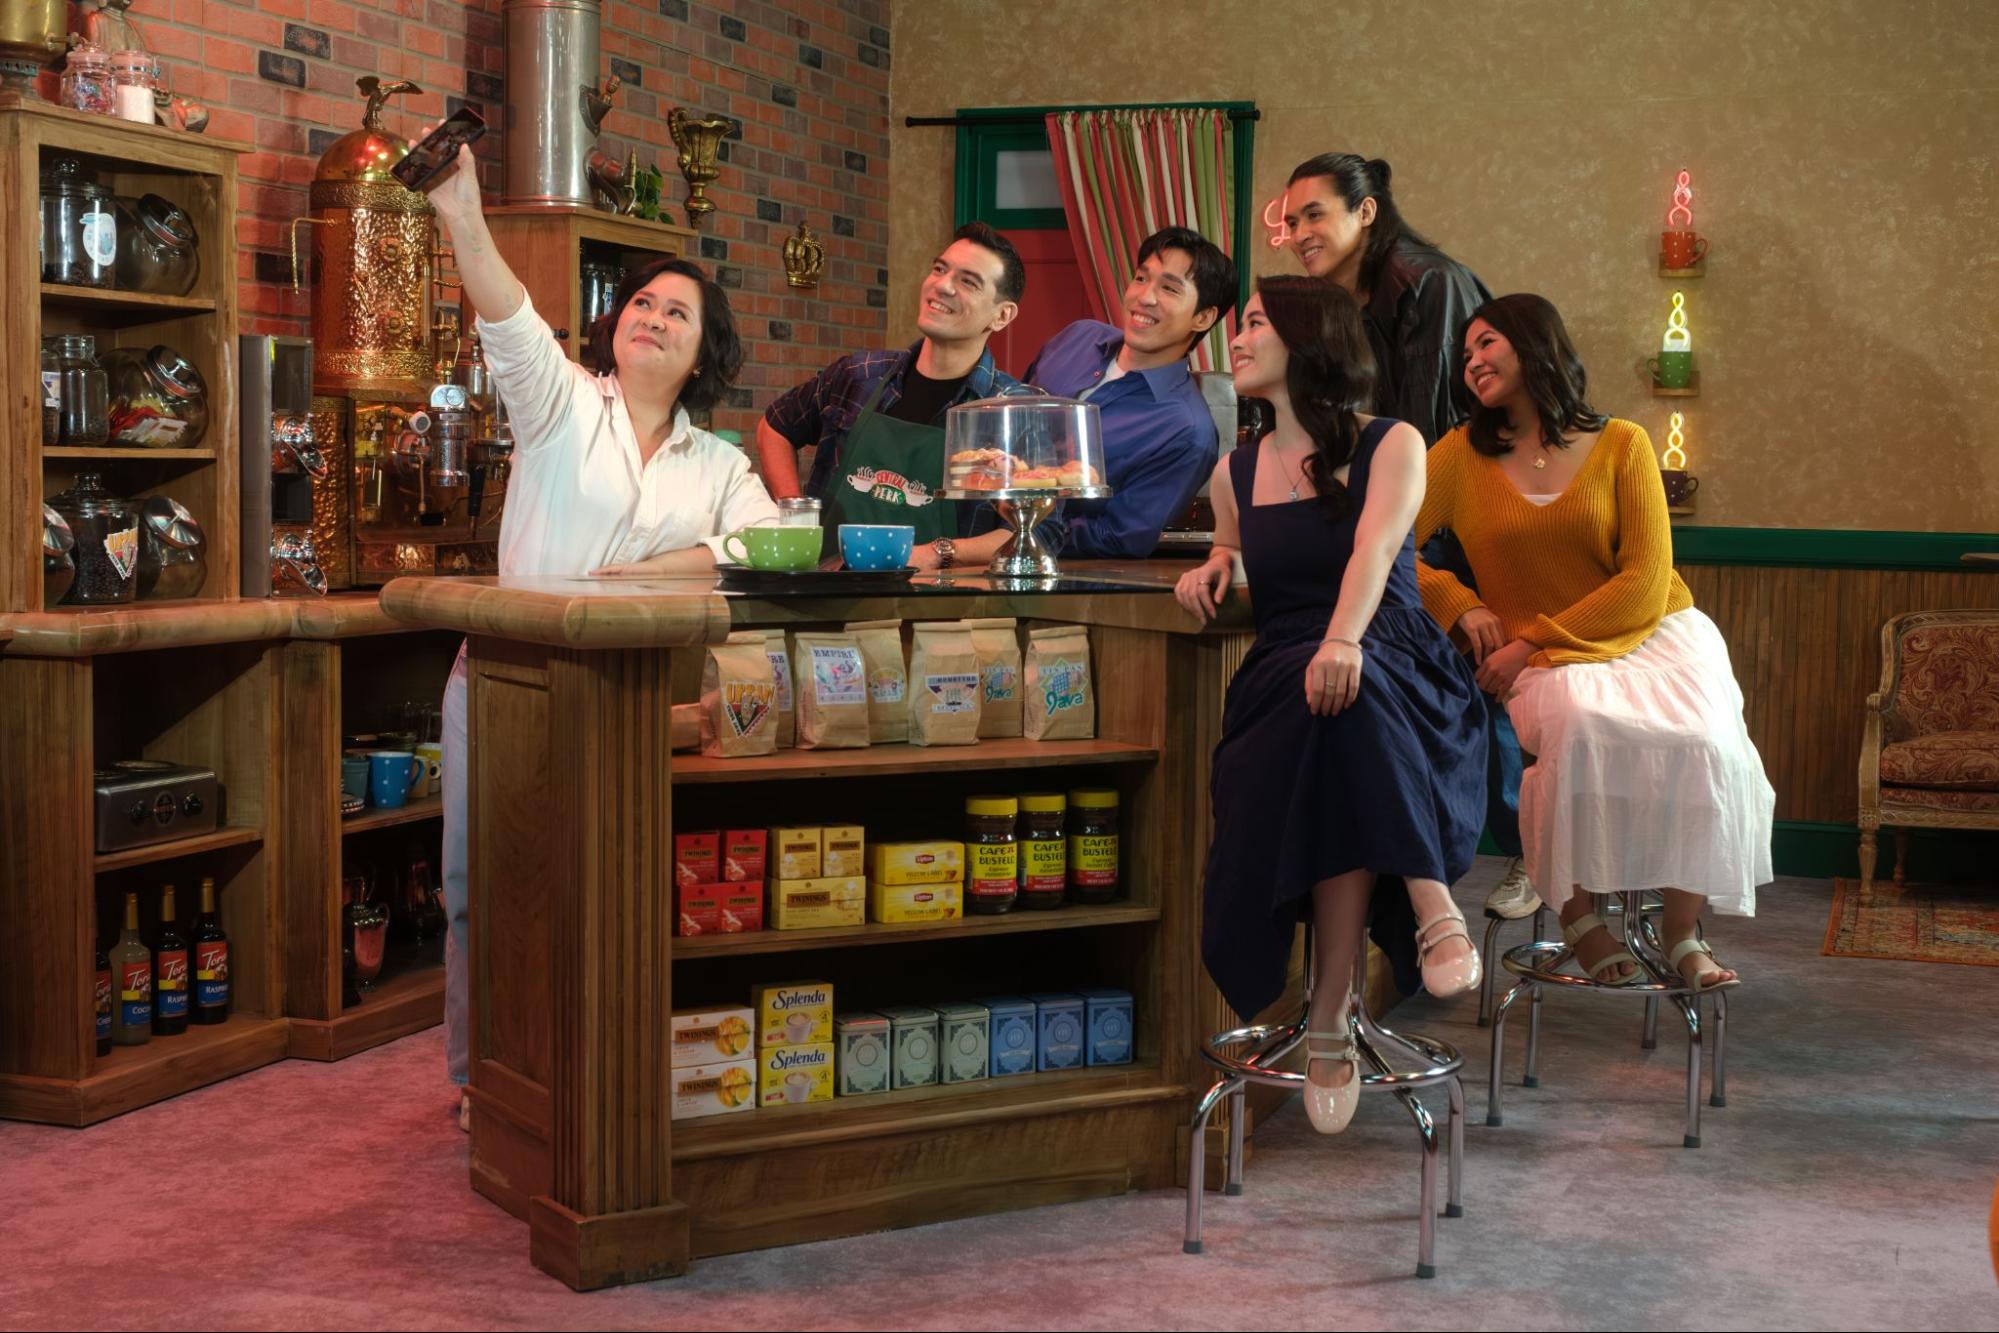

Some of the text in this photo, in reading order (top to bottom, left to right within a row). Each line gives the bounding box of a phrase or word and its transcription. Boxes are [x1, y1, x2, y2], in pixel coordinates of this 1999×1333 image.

[876, 471, 907, 490] CENTRAL
[874, 486, 899, 504] PERK
[772, 990, 826, 1010] Splenda
[679, 1029, 717, 1040] TWININGS
[770, 1049, 826, 1070] Splenda
[682, 1080, 720, 1092] TWININGS
